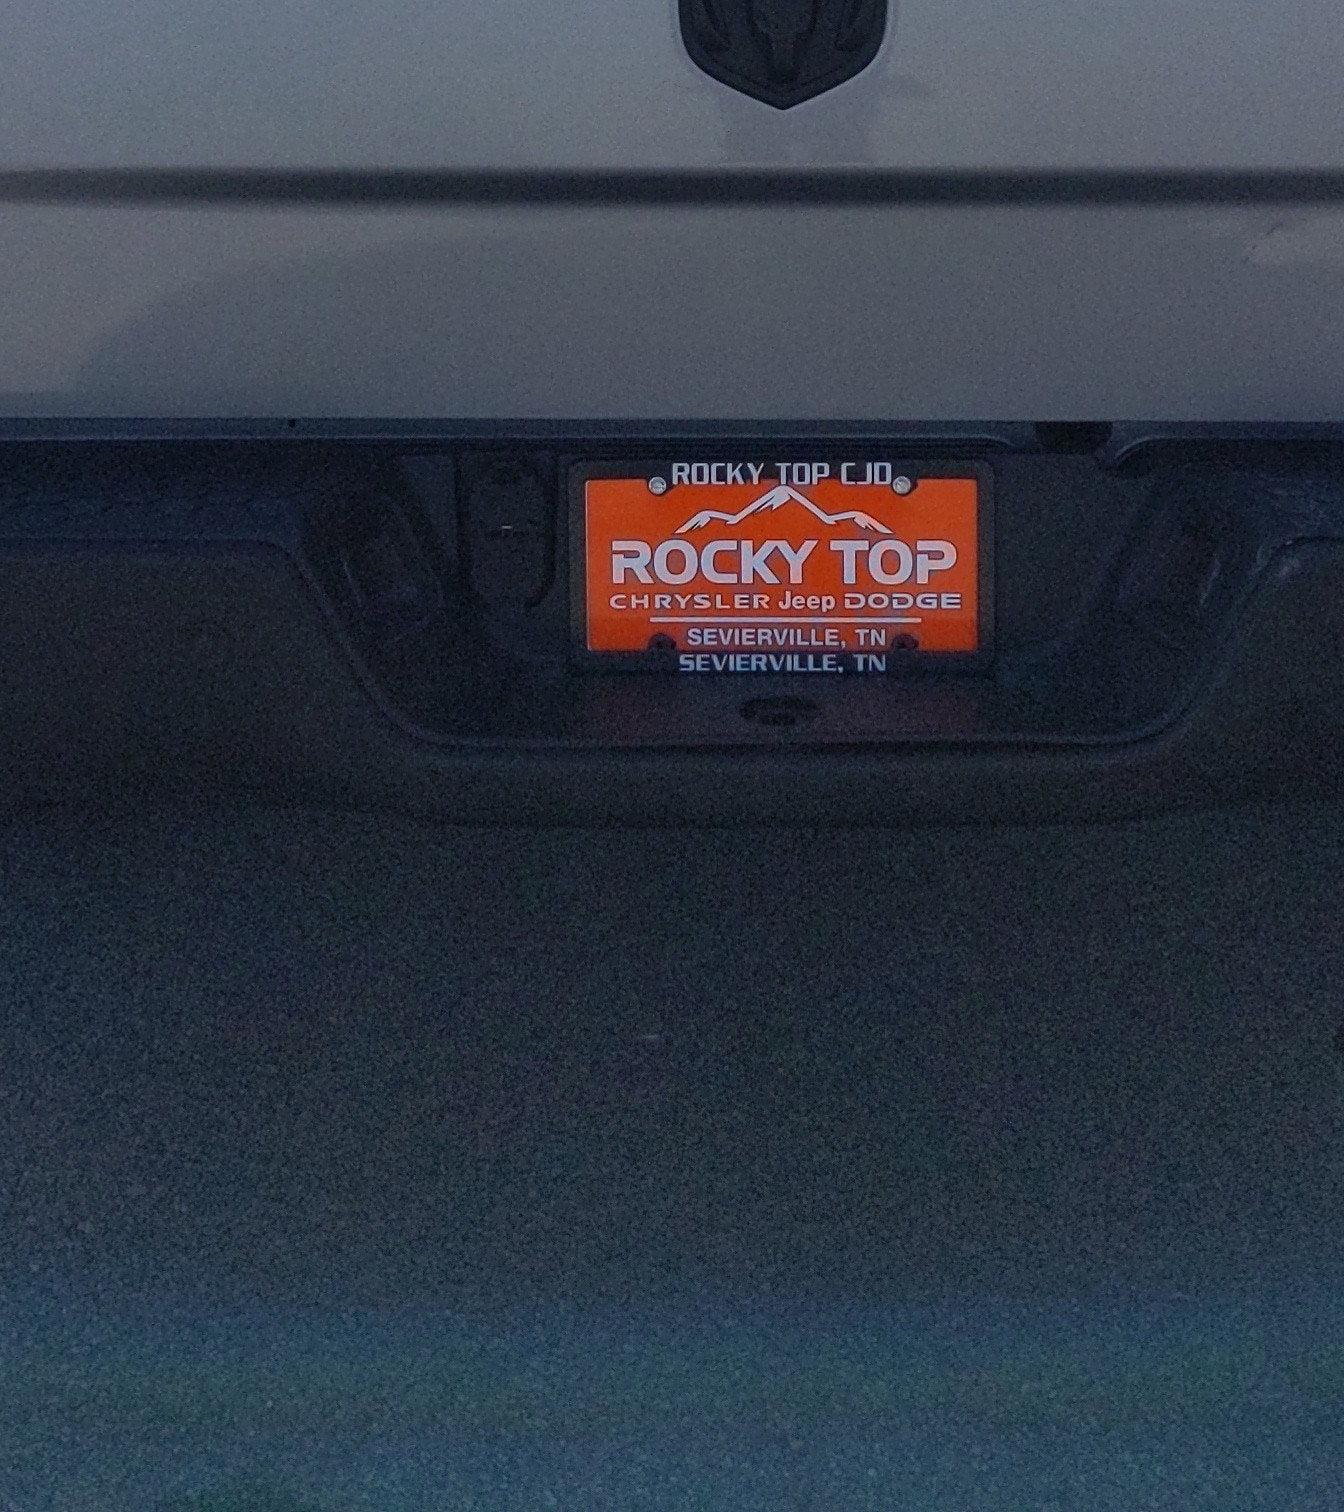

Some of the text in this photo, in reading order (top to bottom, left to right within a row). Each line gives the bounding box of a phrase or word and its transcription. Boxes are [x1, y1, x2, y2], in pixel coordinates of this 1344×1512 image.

[672, 462, 892, 486] ROCKY TOP CJD
[611, 539, 958, 585] ROCKY TOP
[609, 590, 962, 613] CHRYSLER Jeep DODGE
[687, 628, 886, 649] SEVIERVILLE, TN
[678, 653, 886, 673] SEVIERVILLE, TN
